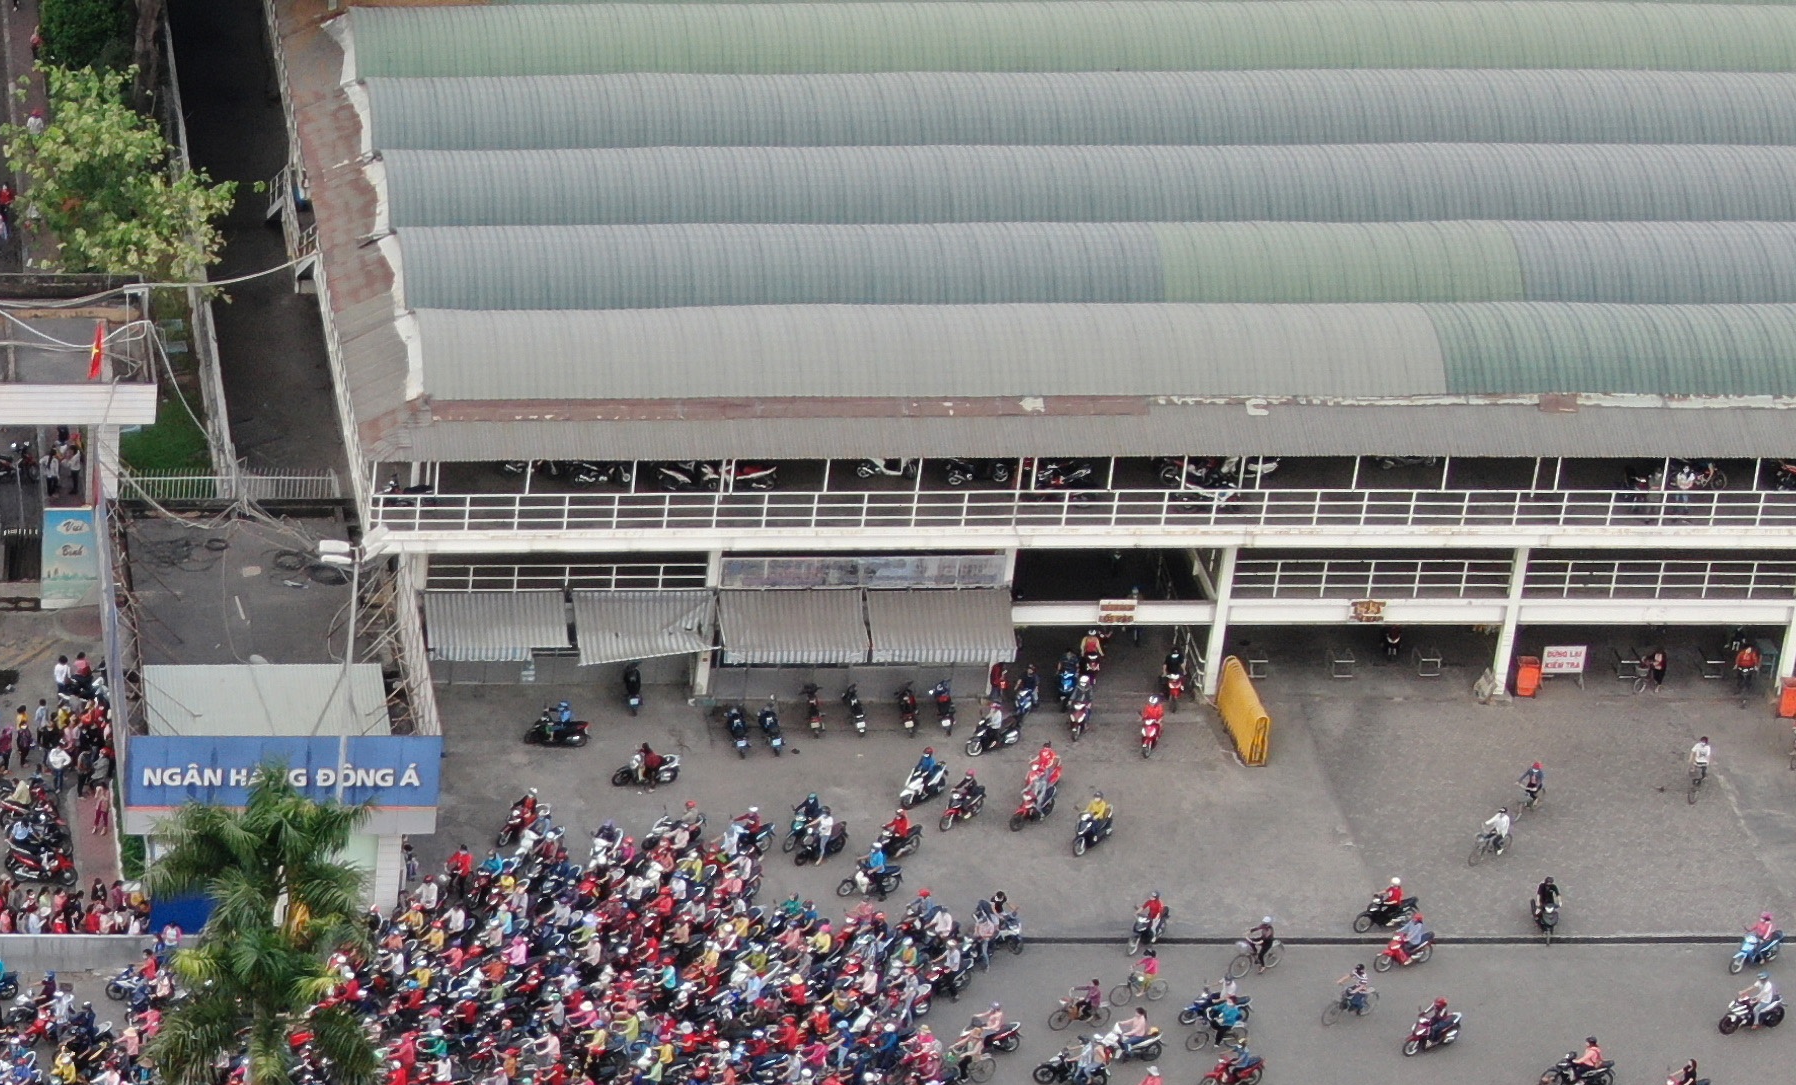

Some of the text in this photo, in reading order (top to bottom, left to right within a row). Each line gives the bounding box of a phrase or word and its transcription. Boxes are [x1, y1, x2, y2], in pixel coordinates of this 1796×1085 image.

[143, 762, 223, 787] NGÂN
[315, 763, 394, 787] ĐÔNG
[399, 762, 421, 787] Á
